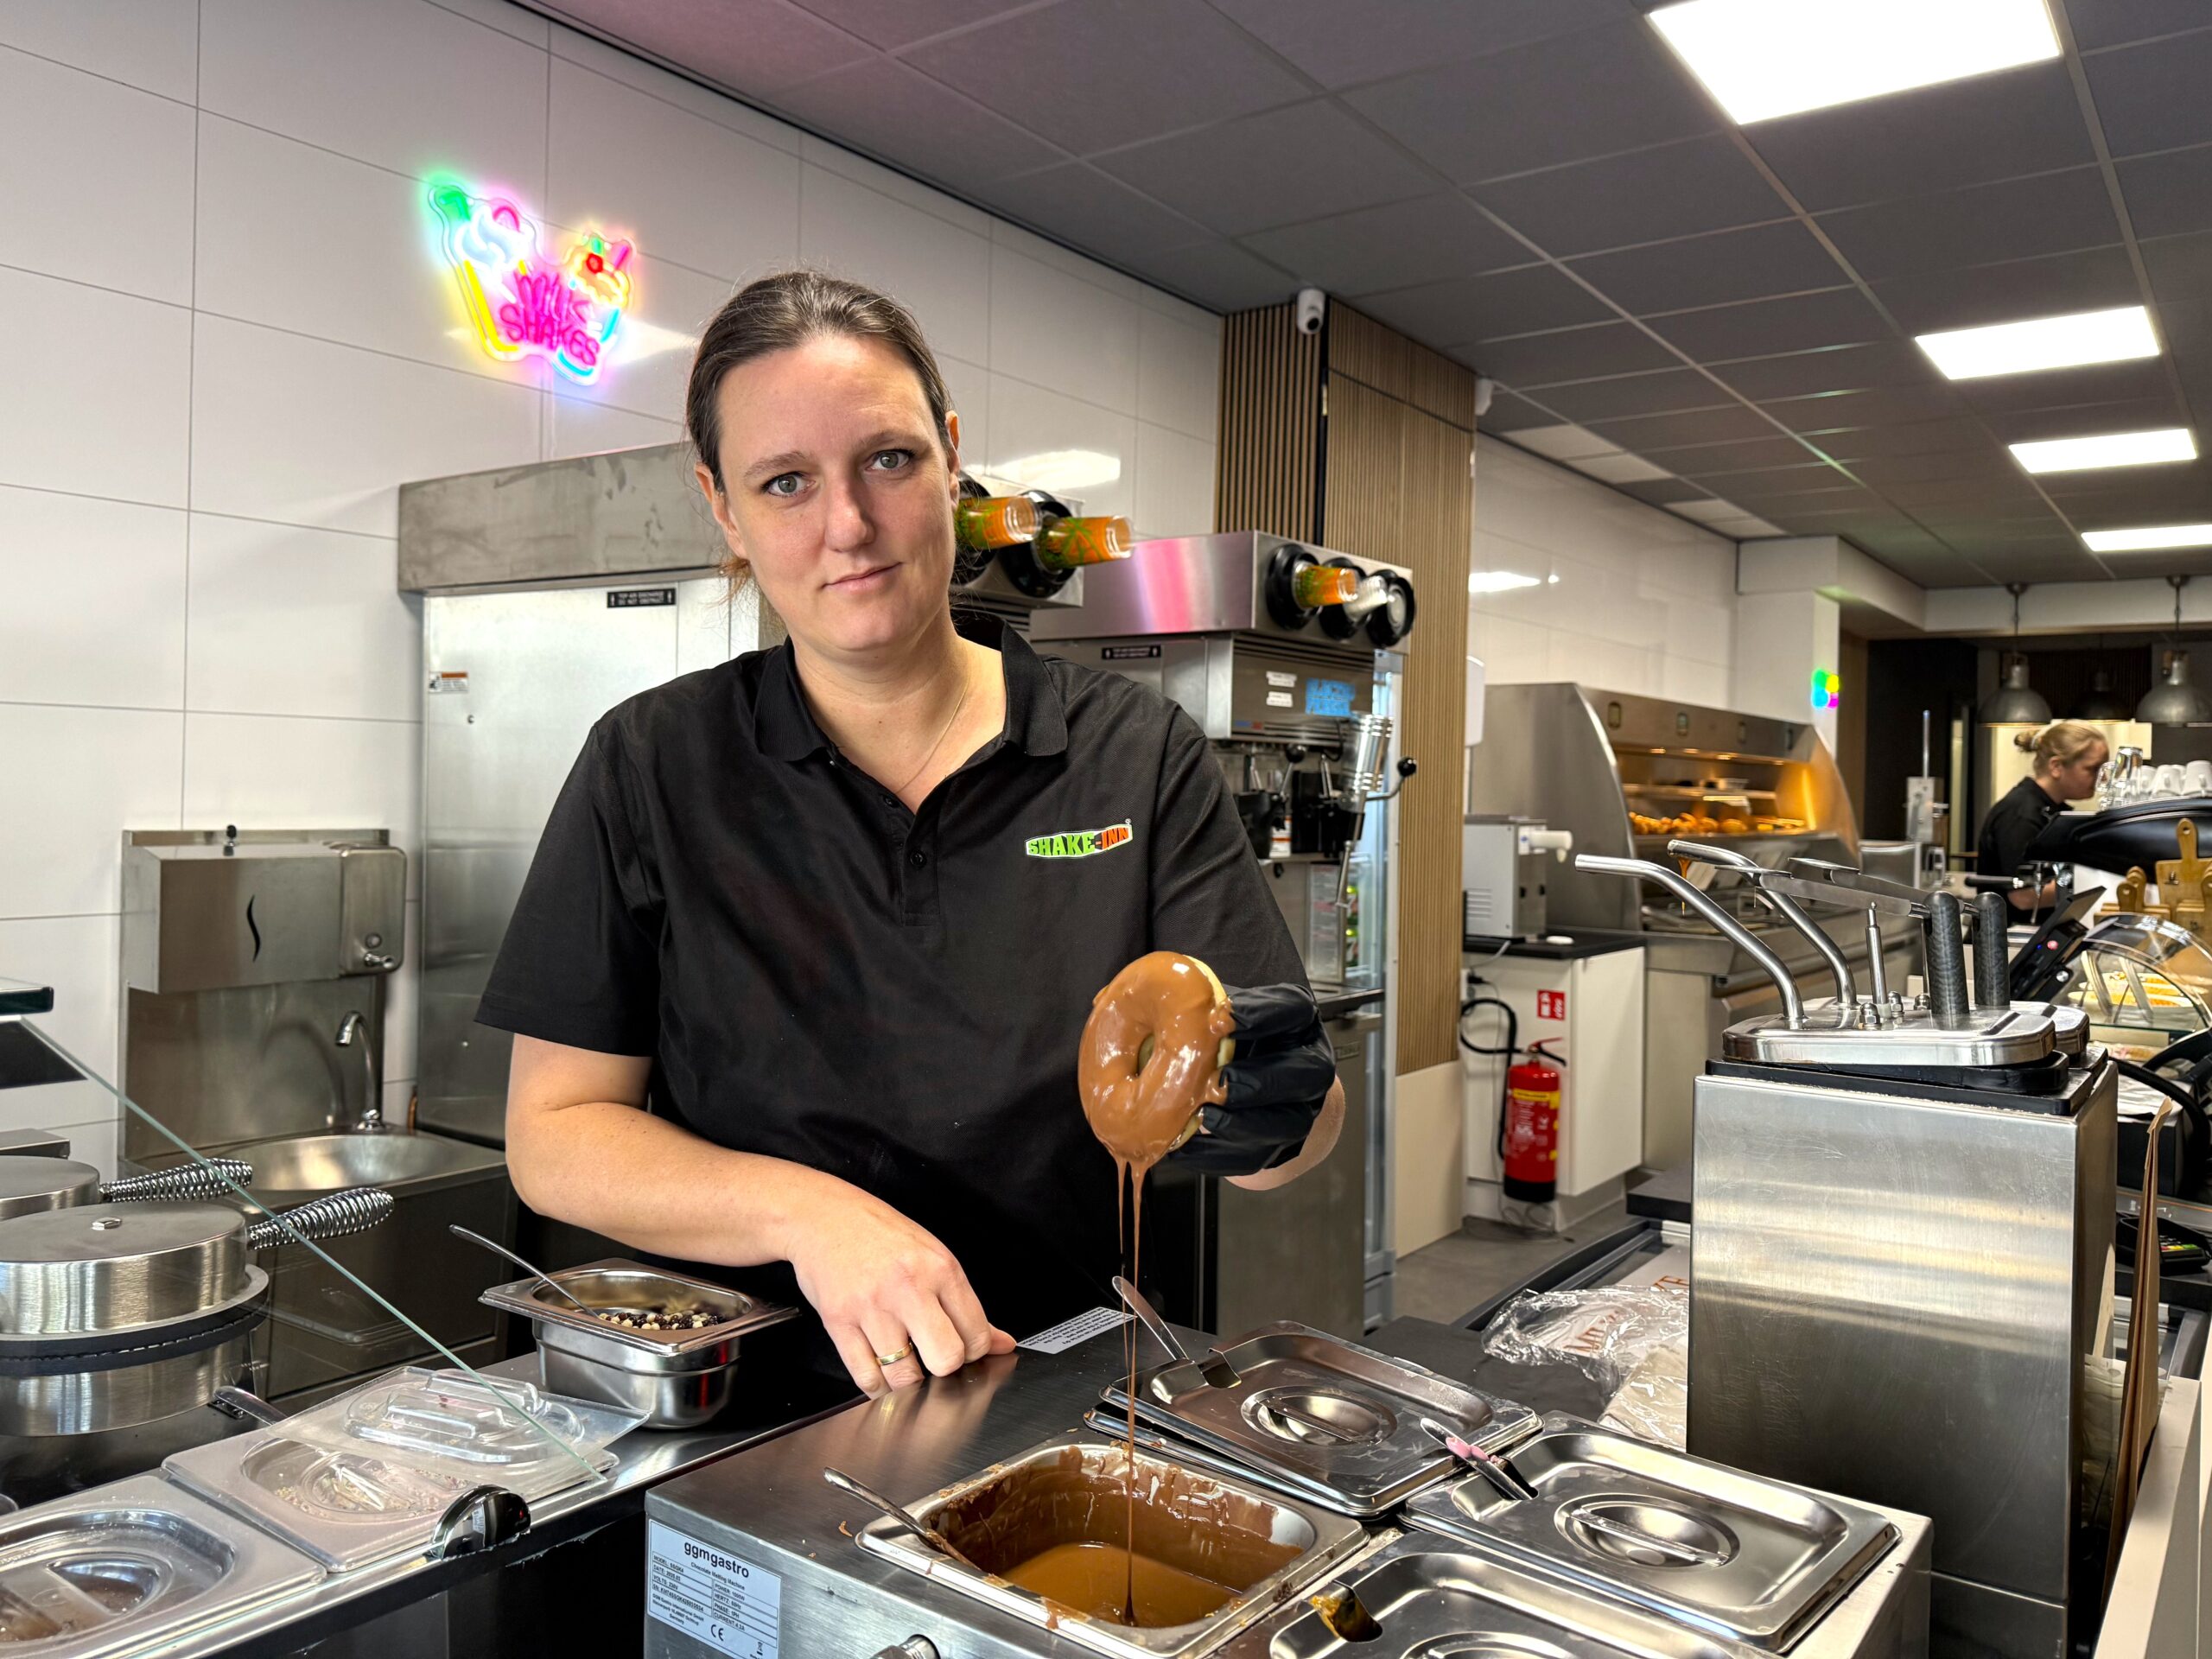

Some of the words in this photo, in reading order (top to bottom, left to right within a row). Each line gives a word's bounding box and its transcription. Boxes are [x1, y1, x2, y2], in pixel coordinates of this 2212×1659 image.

[513, 270, 589, 324] MILK
[499, 303, 599, 365] SHAKES
[1027, 827, 1130, 856] SHAKE-INN
[684, 1541, 749, 1578] ggmgastro
